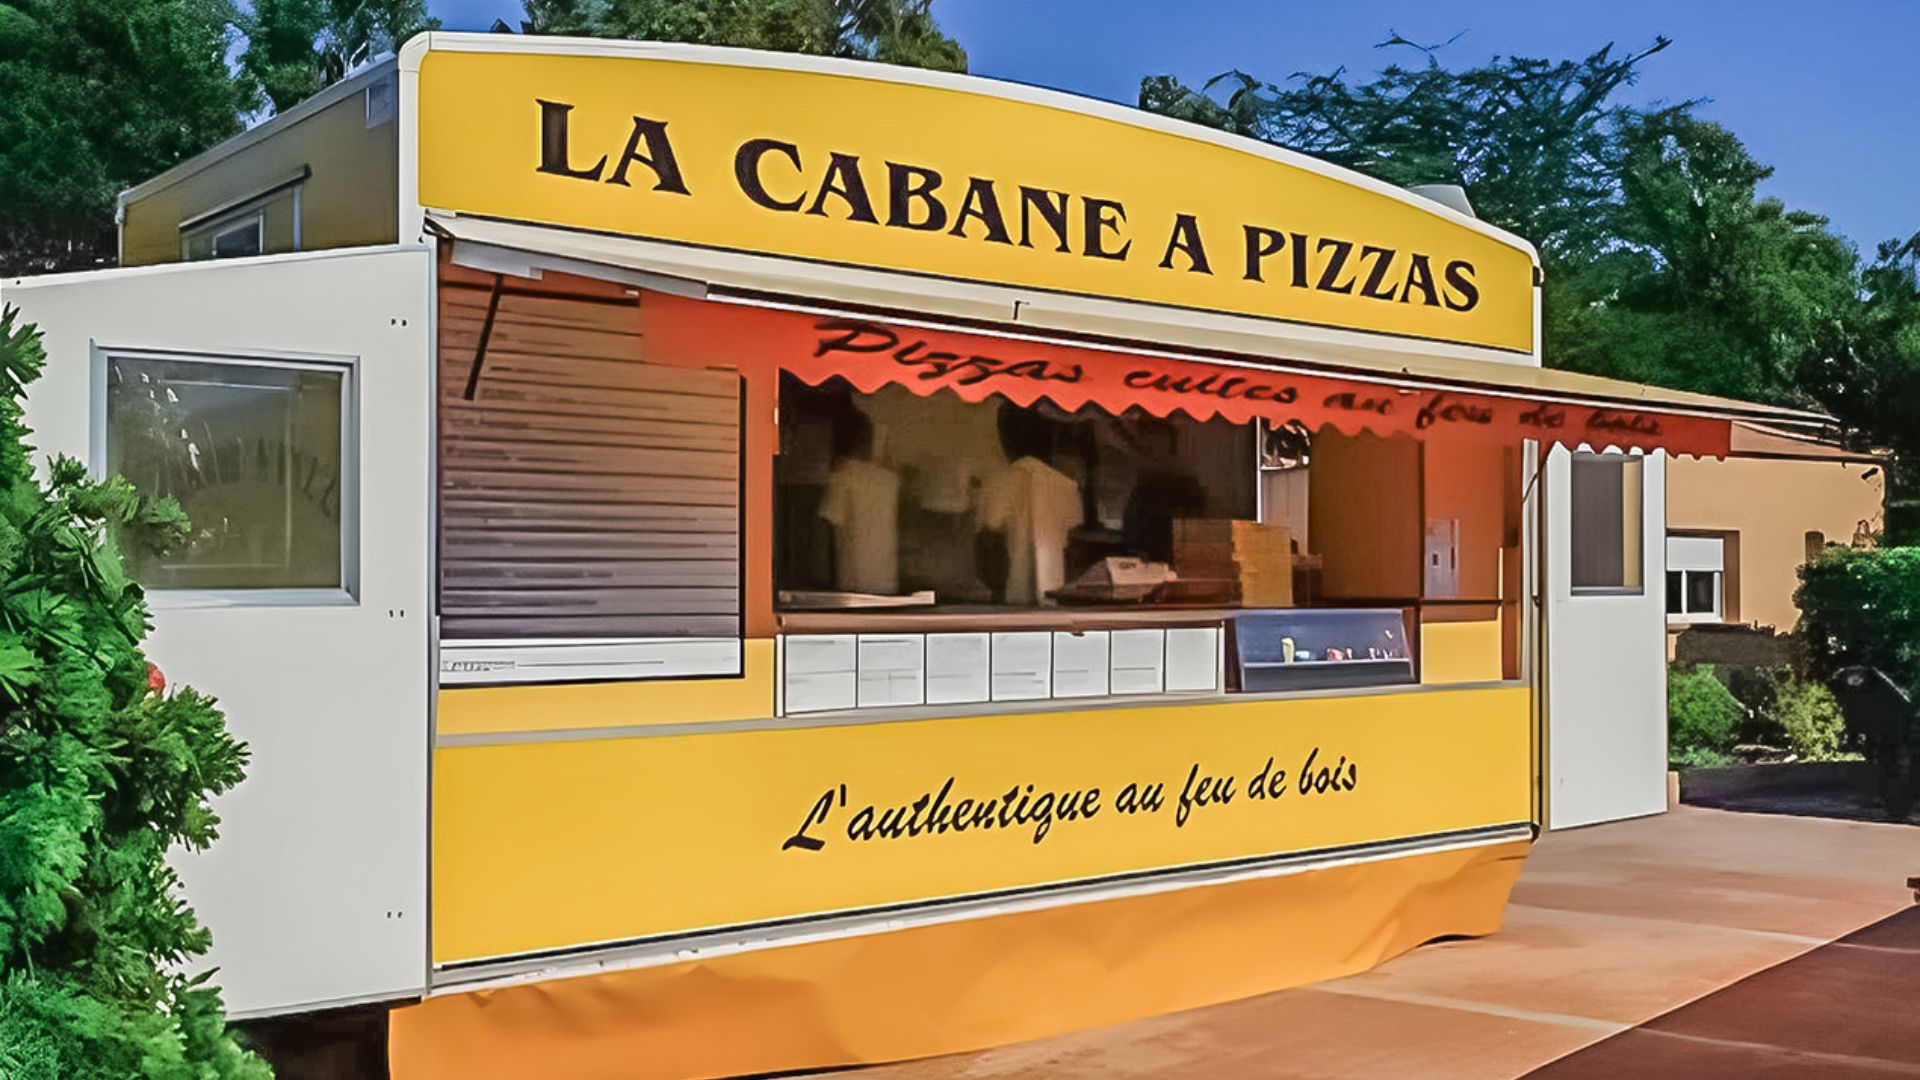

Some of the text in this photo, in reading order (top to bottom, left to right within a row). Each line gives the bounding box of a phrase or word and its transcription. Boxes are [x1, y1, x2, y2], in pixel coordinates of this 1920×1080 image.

[535, 98, 1480, 312] LA CABANE A PIZZAS
[814, 320, 1084, 384] Pizzas
[781, 747, 1357, 851] L'authentique au feu de bois
